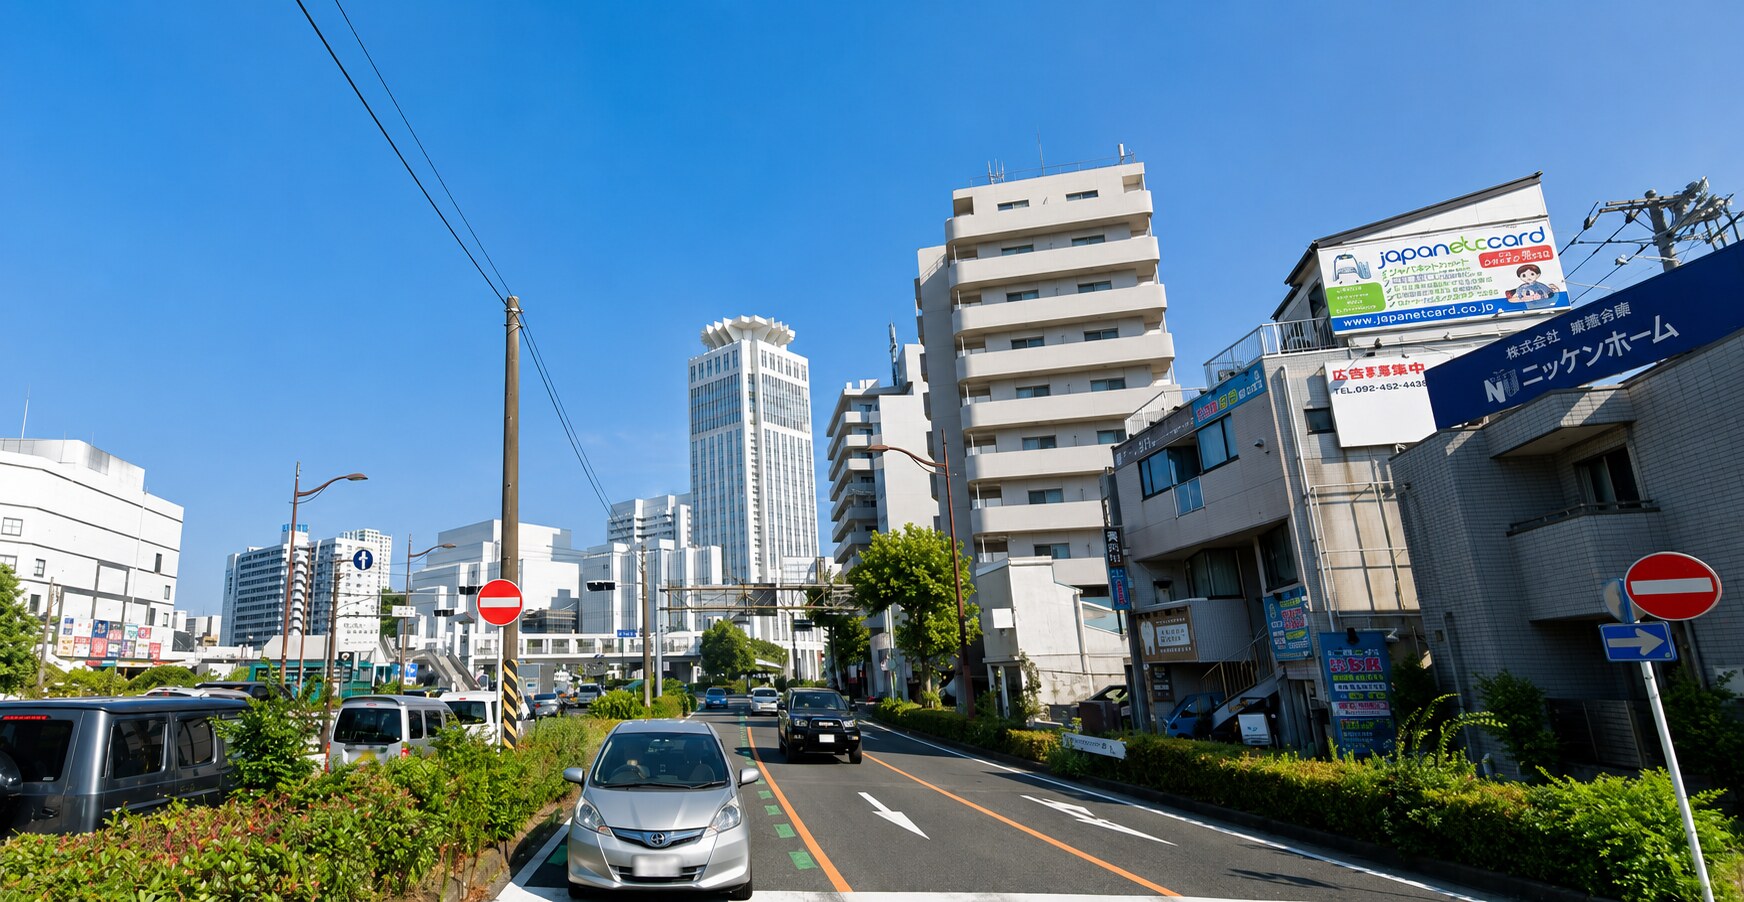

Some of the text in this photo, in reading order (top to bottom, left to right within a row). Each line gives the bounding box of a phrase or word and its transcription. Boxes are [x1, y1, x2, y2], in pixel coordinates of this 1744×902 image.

[1343, 302, 1494, 327] www.japanetcard.co.jp
[1505, 328, 1561, 361] 株式会社
[1522, 314, 1680, 387] ニッケンホーム
